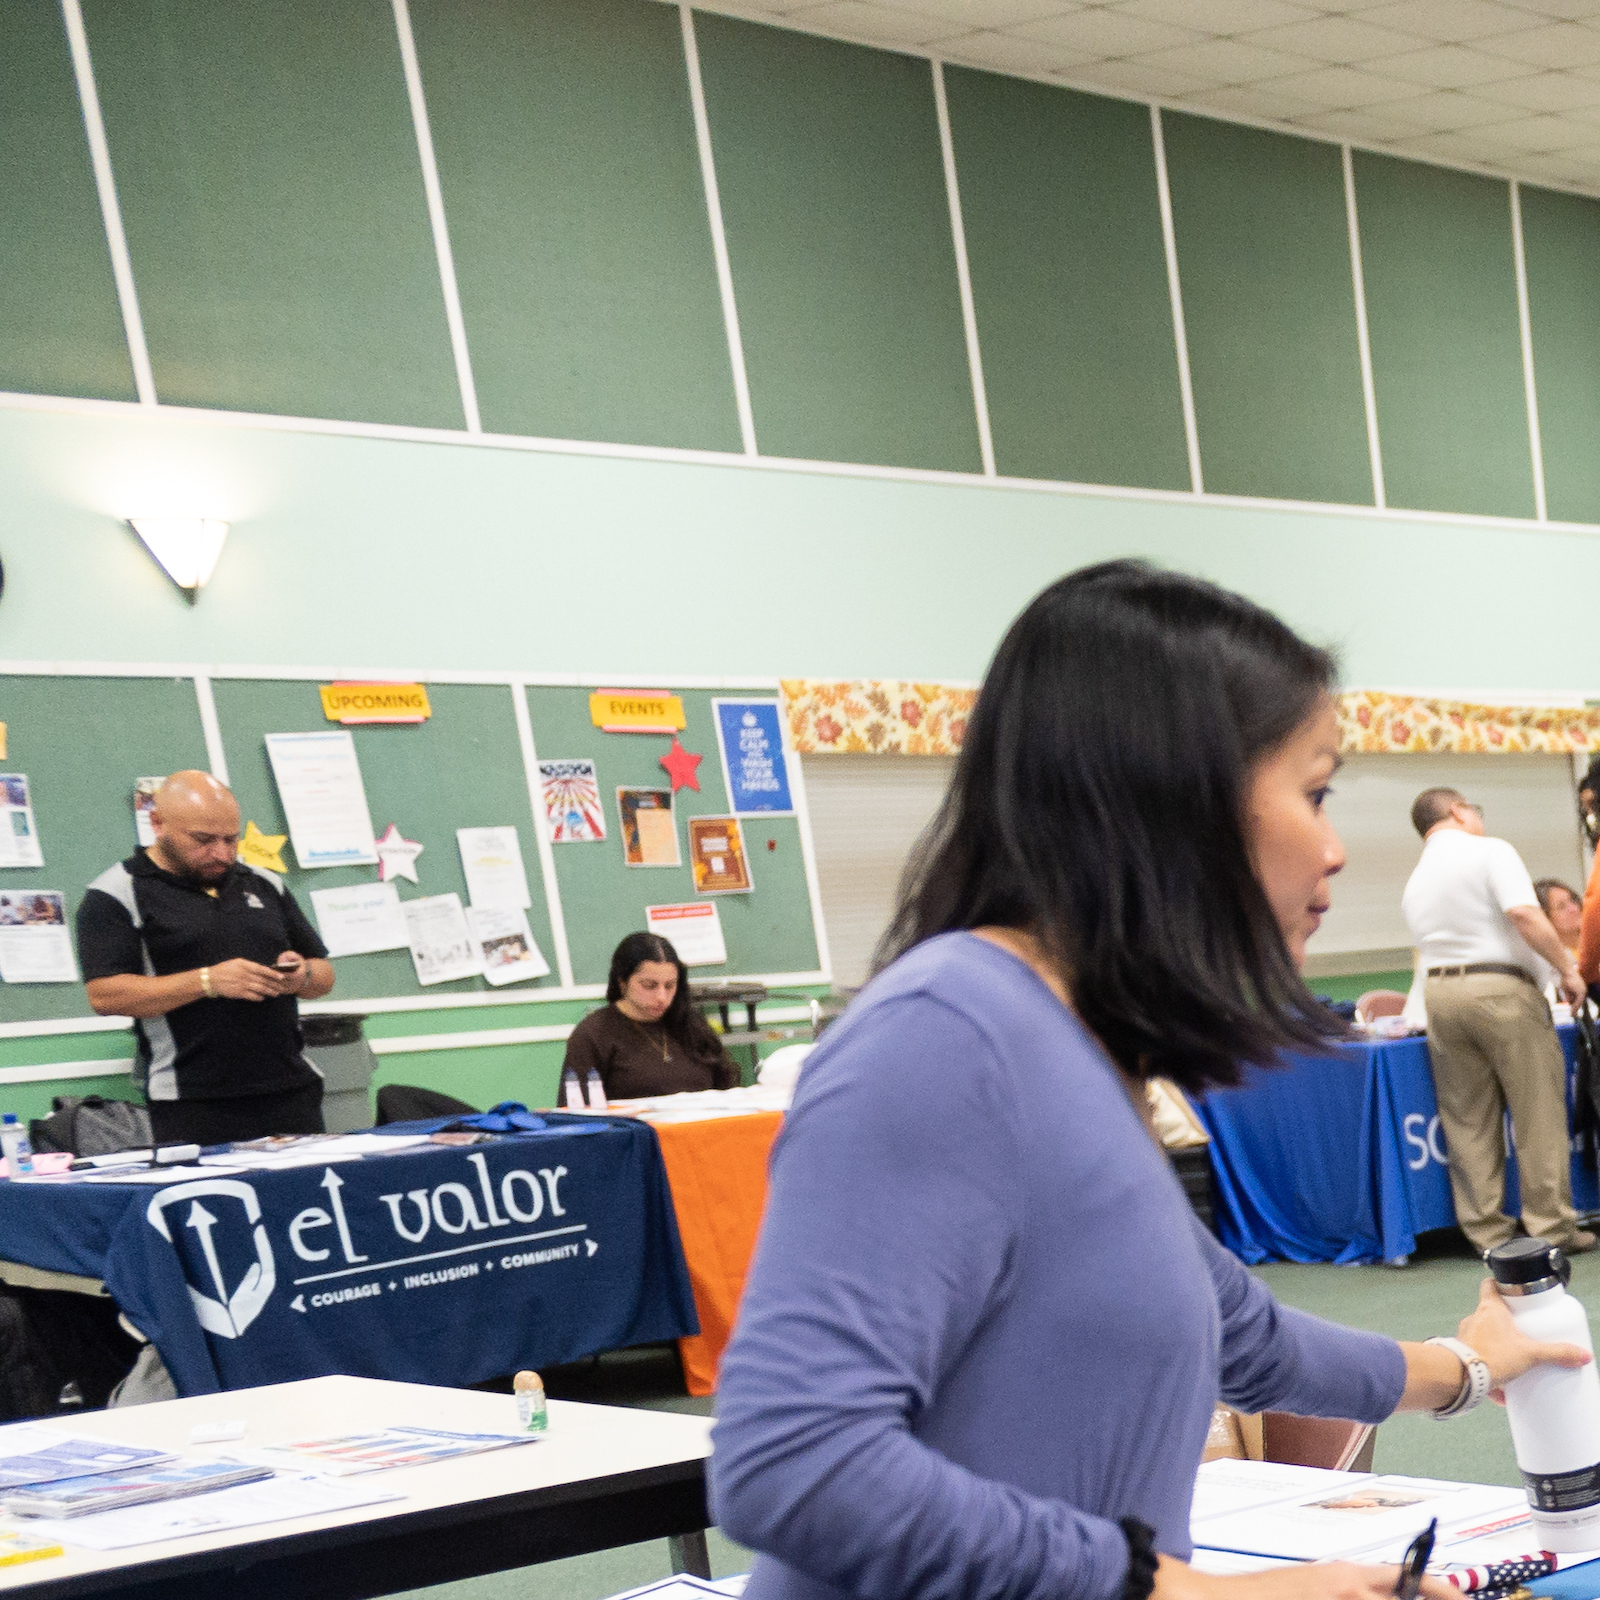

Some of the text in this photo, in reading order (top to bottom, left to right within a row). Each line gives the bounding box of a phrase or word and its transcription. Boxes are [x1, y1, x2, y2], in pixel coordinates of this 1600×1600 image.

[326, 692, 424, 711] UPCOMING
[609, 700, 666, 717] EVENTS
[288, 1152, 568, 1264] el valor
[310, 1282, 381, 1308] COURAGE
[404, 1262, 479, 1290] INCLUSION
[501, 1243, 579, 1270] COMMUNITY
